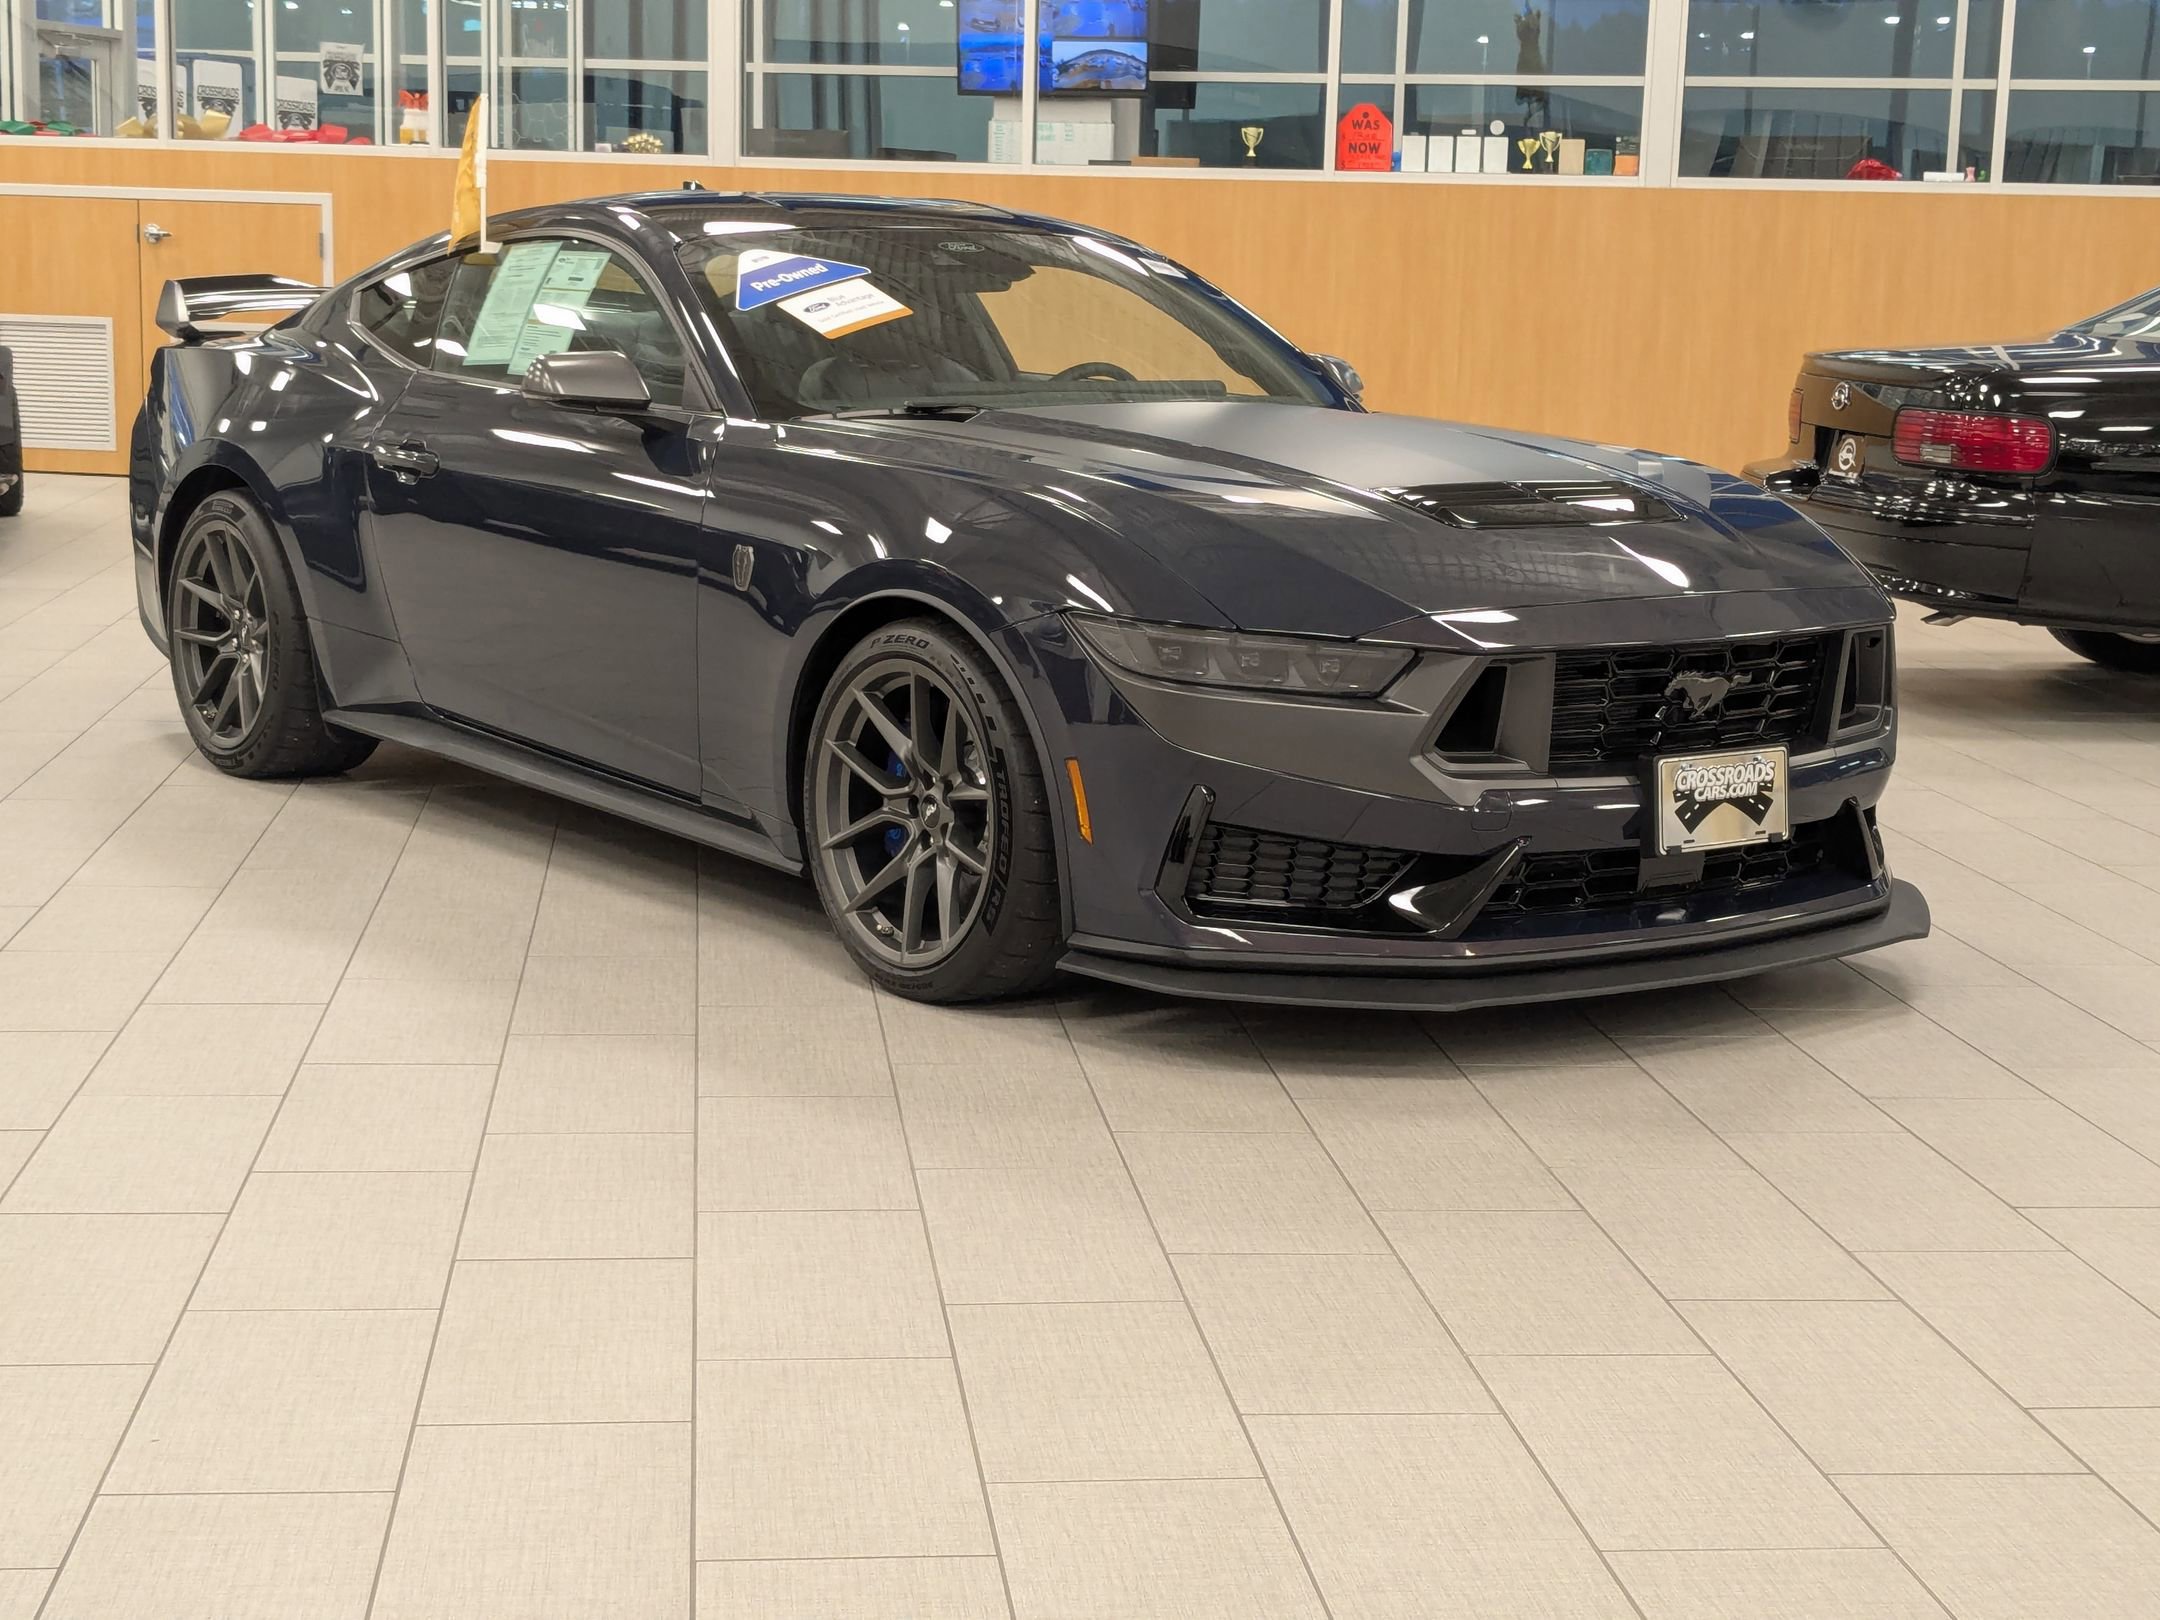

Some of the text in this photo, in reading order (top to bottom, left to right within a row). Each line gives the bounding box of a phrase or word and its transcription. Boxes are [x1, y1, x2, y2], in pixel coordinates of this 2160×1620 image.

[1352, 119, 1380, 130] WAS
[1348, 142, 1381, 154] NOW
[750, 263, 829, 292] Pre-Owned
[883, 634, 930, 649] ZERO
[1675, 761, 1776, 791] CROSSROADS
[1694, 782, 1758, 802] CARS.COM
